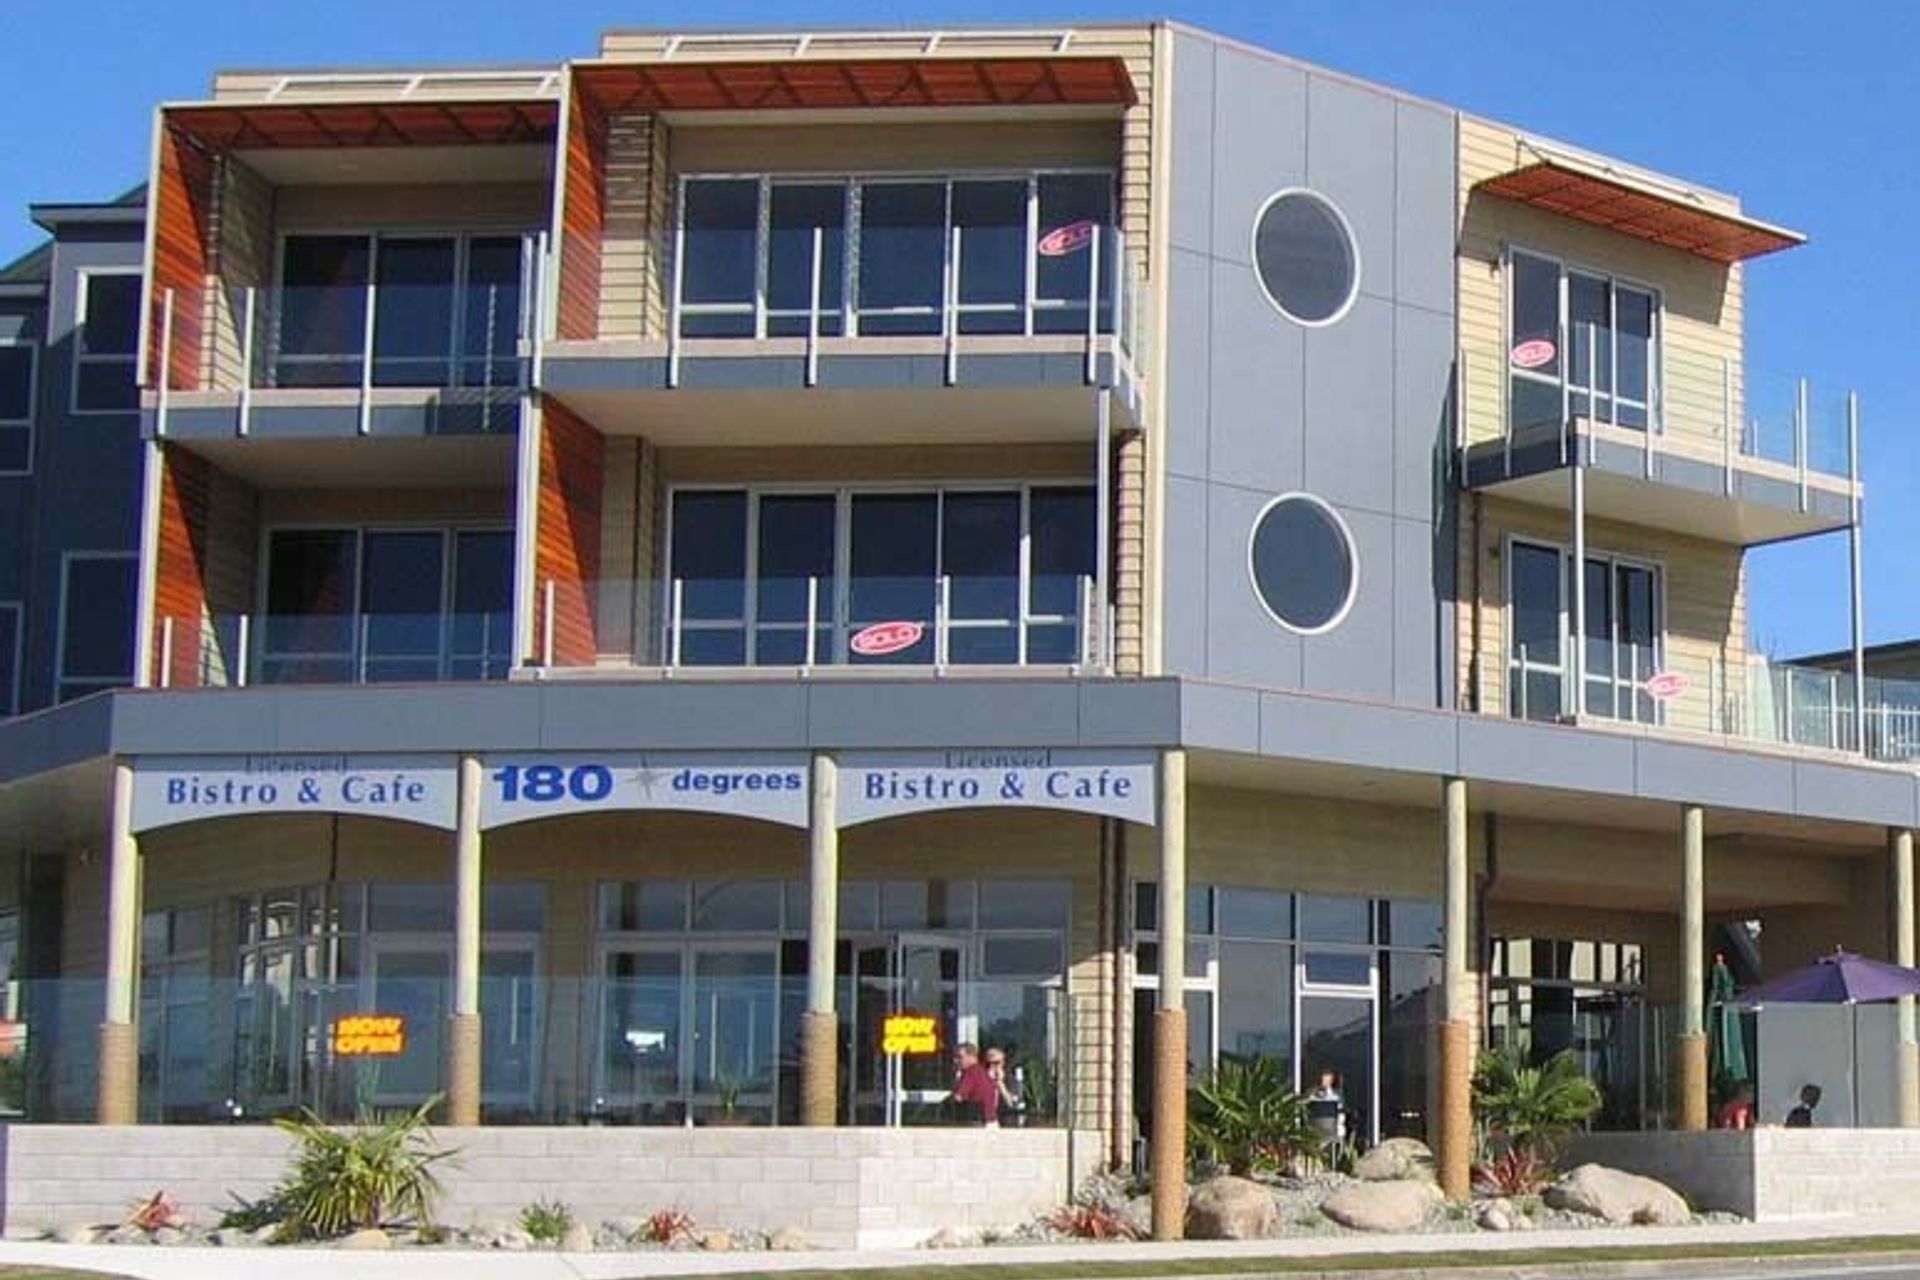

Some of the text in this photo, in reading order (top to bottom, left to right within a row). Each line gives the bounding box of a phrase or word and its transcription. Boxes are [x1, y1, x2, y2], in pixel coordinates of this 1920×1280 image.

[167, 773, 425, 805] Bistro & Cafe
[493, 764, 802, 802] 180 degrees
[865, 769, 1132, 800] Bistro & Cafe
